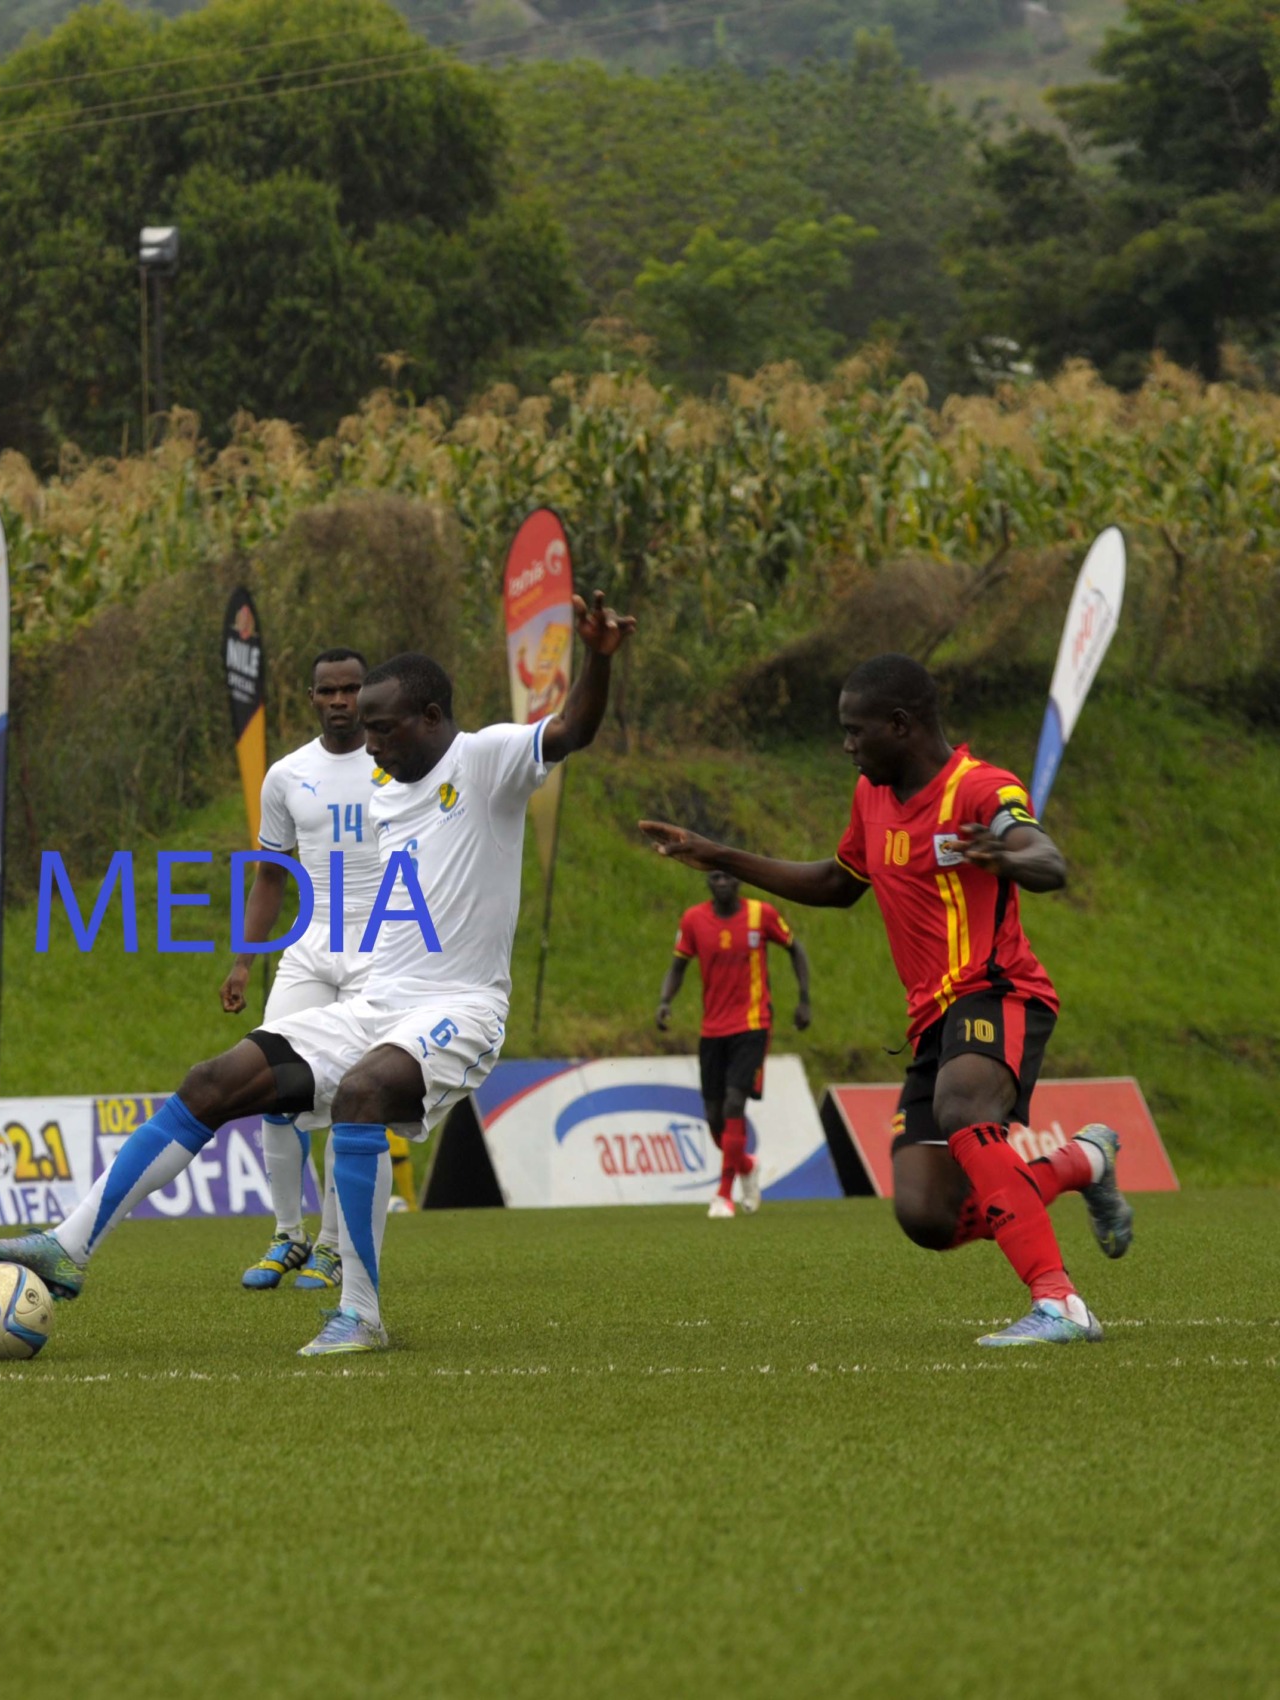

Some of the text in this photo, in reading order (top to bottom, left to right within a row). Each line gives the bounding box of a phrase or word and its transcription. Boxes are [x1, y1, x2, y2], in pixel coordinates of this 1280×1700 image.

[327, 803, 363, 843] 14
[884, 829, 910, 866] 10
[429, 1017, 459, 1048] 6
[964, 1018, 995, 1043] 10
[97, 1098, 154, 1134] 1021
